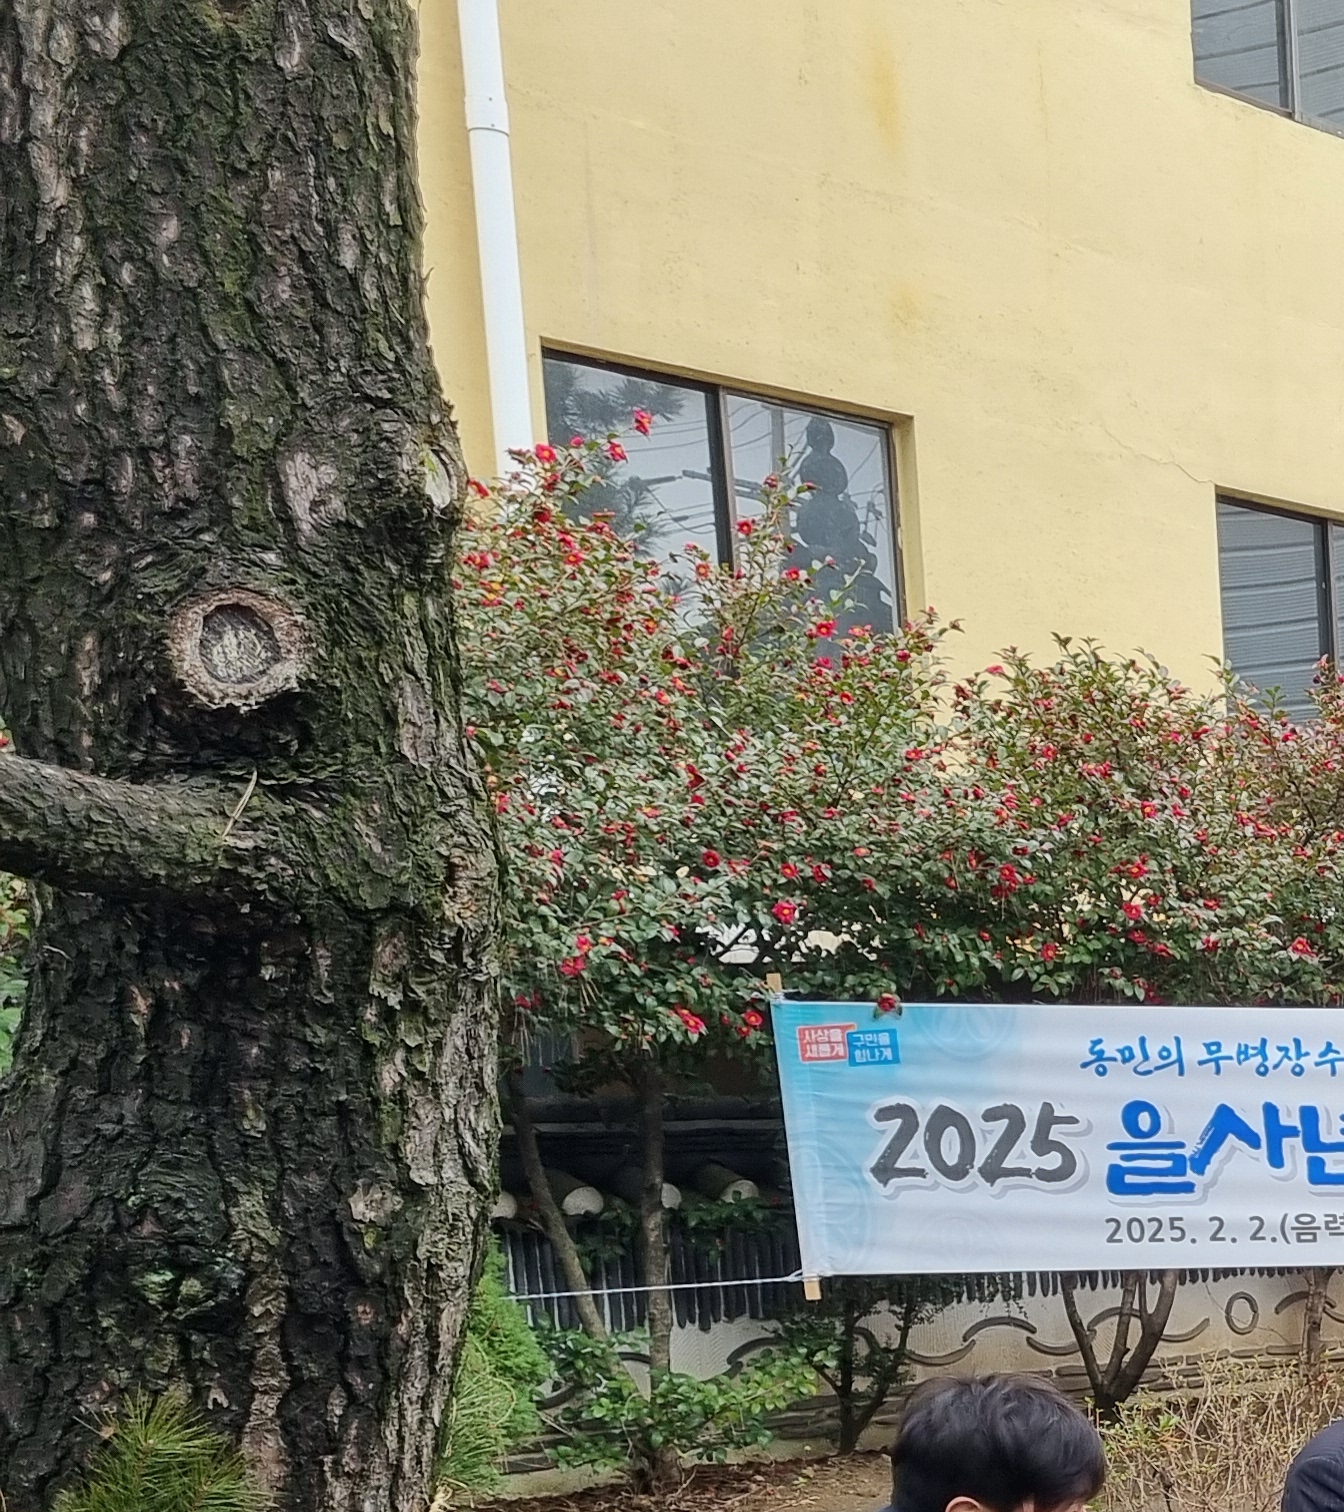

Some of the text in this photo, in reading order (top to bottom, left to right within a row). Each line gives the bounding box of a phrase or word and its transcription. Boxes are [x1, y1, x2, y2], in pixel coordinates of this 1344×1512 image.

[804, 1028, 842, 1044] 사상을
[852, 1032, 891, 1047] 구민을
[1079, 1036, 1185, 1077] 동민의
[869, 1101, 1080, 1188] 2025
[1105, 1216, 1198, 1245] 2025.
[1208, 1216, 1238, 1244] 2.
